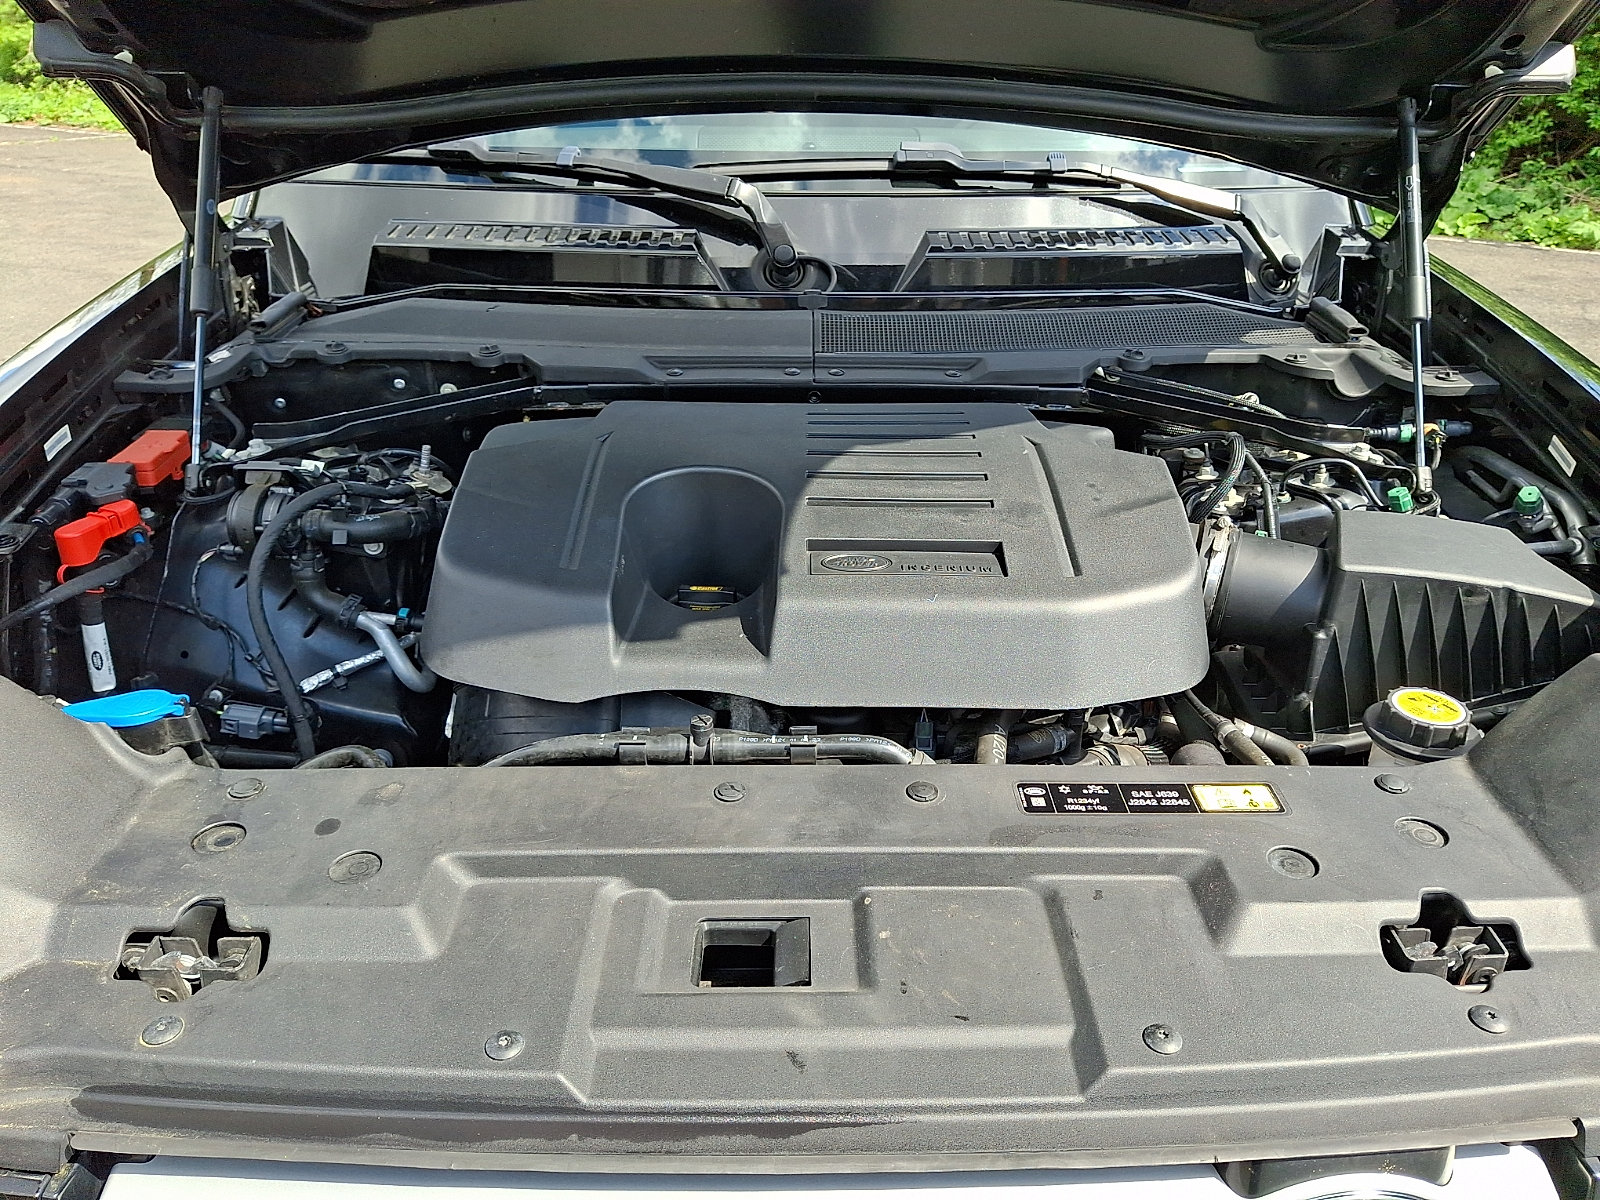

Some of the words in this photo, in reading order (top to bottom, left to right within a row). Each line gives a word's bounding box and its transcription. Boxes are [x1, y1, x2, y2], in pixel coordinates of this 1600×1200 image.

[900, 564, 993, 573] INGENIUM
[1131, 790, 1154, 798] SAE
[1155, 790, 1180, 798] J639
[1127, 798, 1159, 806] J2842
[1160, 798, 1191, 806] J2845
